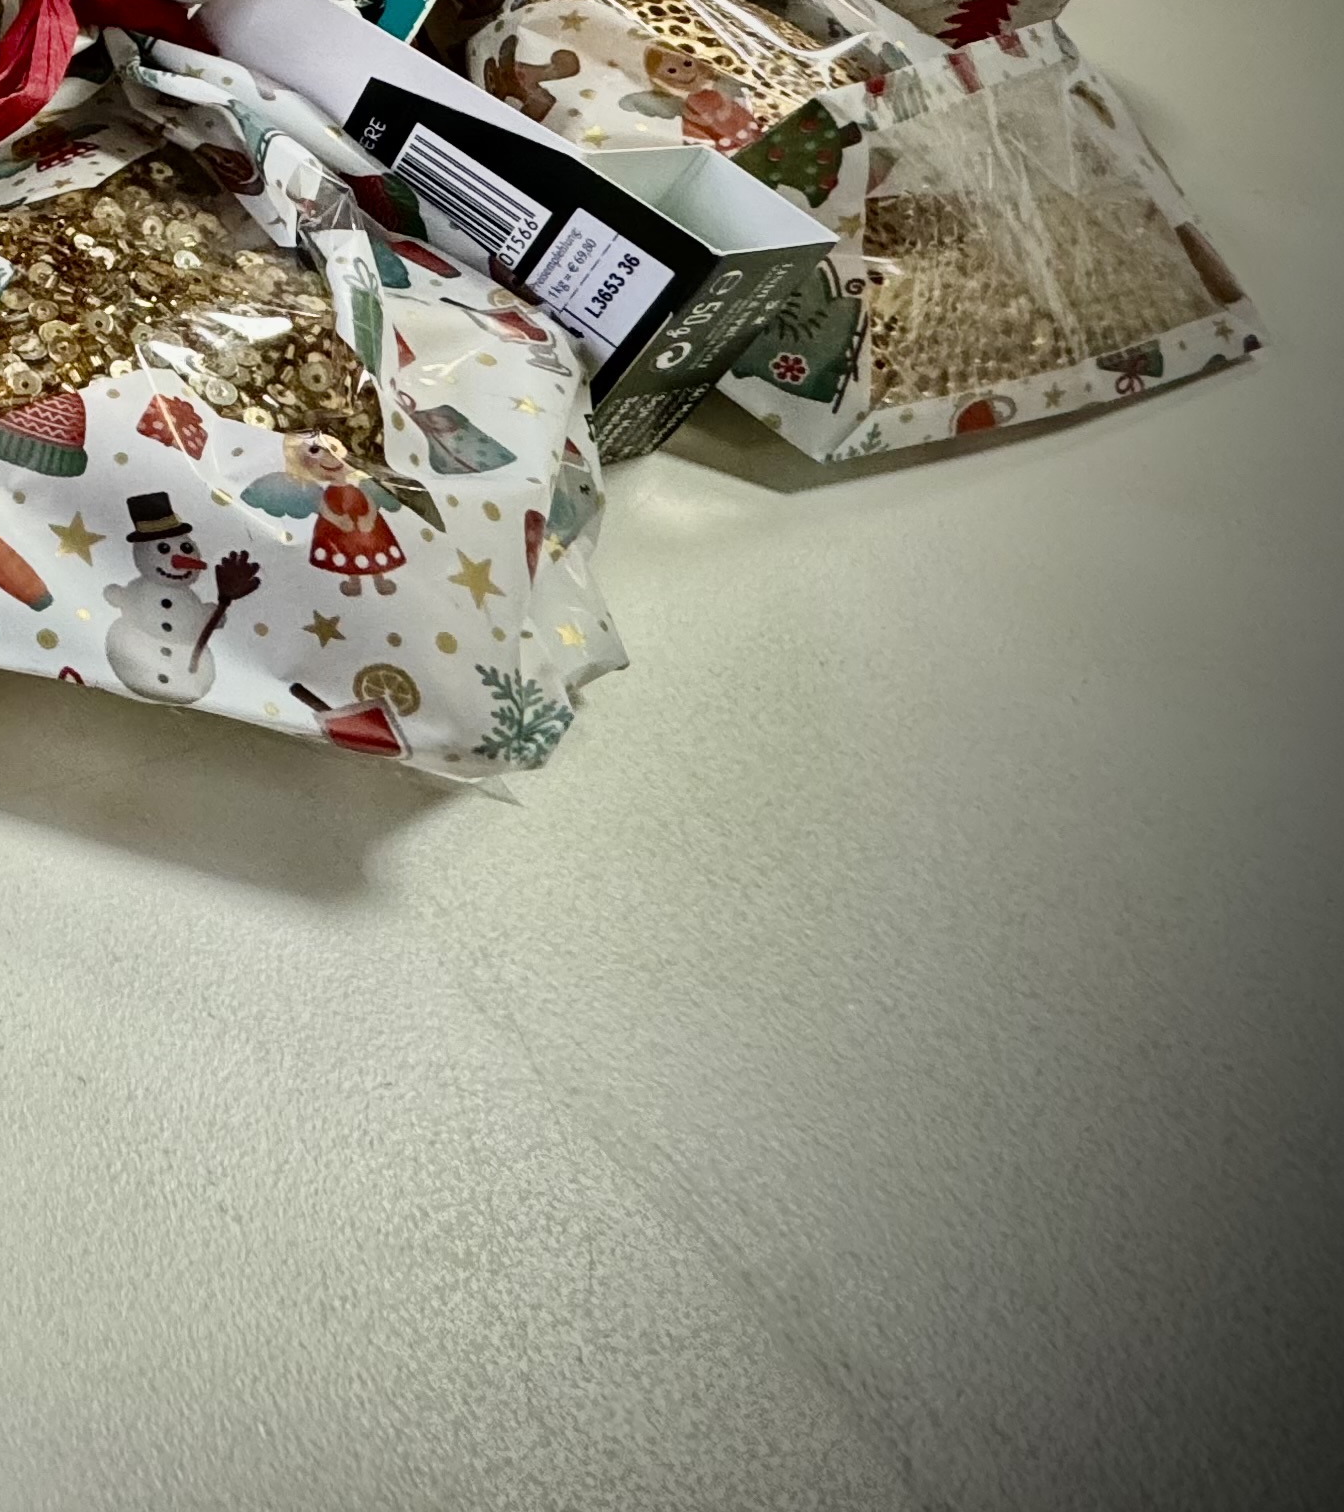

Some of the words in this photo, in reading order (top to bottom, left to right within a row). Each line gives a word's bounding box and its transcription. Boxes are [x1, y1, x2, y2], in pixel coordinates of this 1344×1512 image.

[498, 218, 539, 267] 01566
[585, 272, 625, 318] L3653
[617, 252, 640, 275] 36
